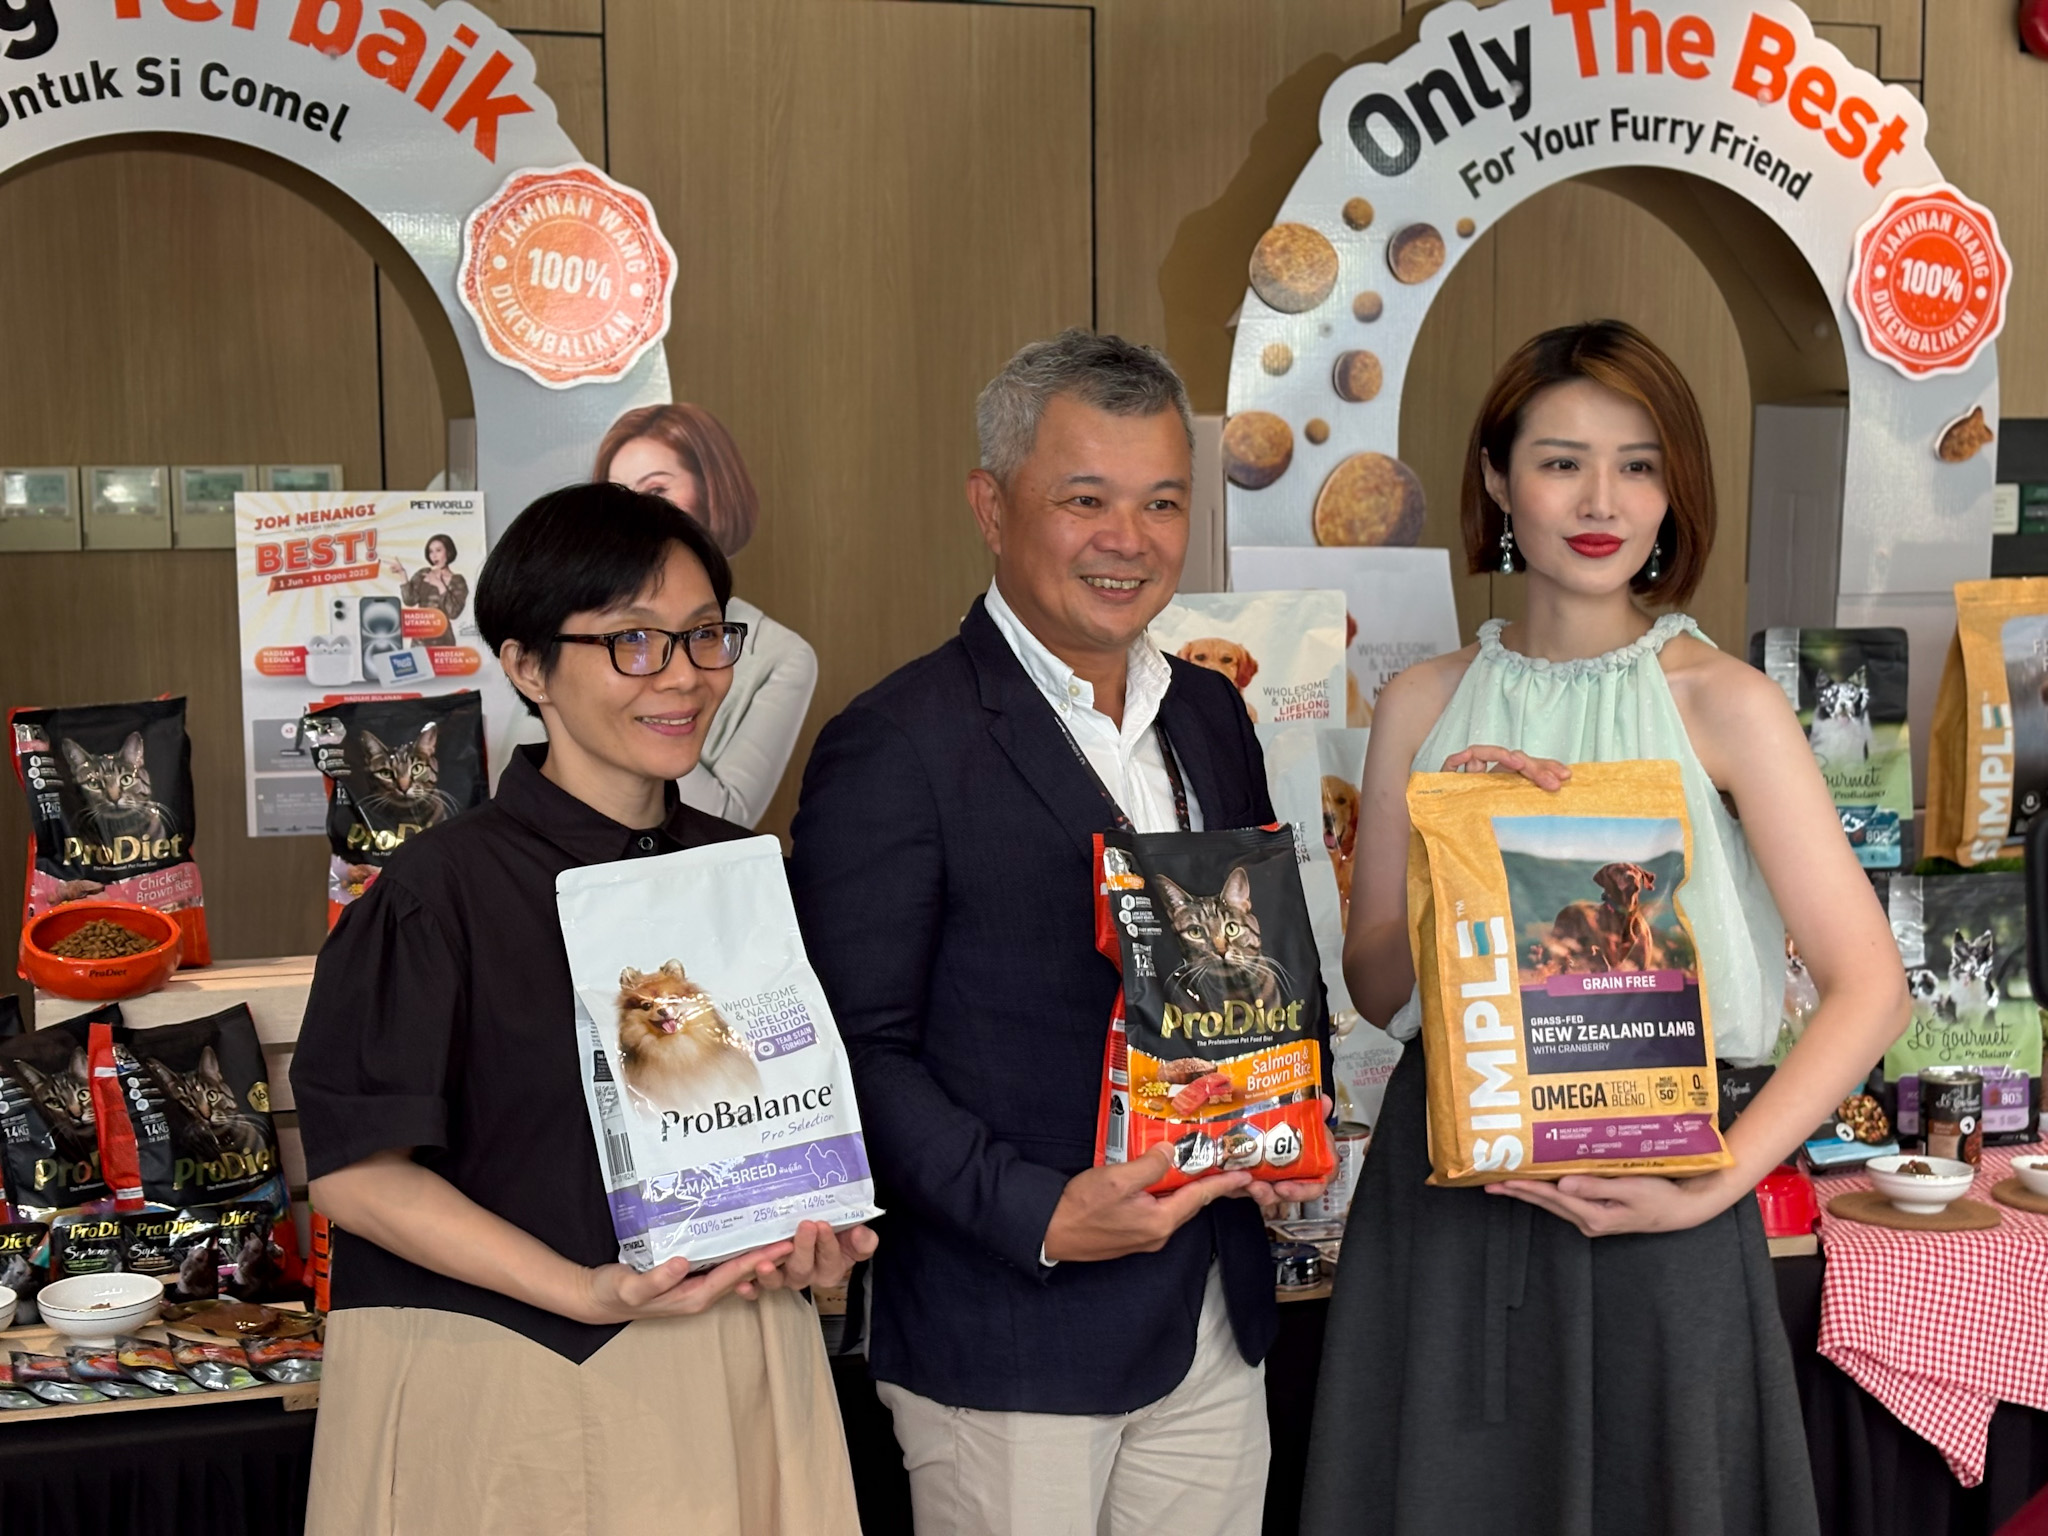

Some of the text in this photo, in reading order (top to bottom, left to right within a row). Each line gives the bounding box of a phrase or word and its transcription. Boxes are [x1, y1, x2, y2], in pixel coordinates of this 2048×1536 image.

[136, 57, 180, 97] Si
[200, 62, 350, 143] Comel
[1348, 0, 1909, 188] Only The Best
[1458, 107, 1813, 201] For Your Furry Friend
[499, 194, 646, 273] JAMINAN WANG
[1880, 210, 1989, 279] JAMINAN WANG
[528, 247, 612, 300] 100%
[1901, 258, 1963, 303] 100%
[490, 284, 635, 358] DIKEMBALIKAN
[1872, 289, 1978, 353] DIKEMBALIKAN
[255, 503, 376, 531] JOM MENANGI
[410, 500, 473, 510] PETWORLD
[255, 528, 377, 576] BEST!
[1263, 678, 1329, 697] WHOLESOME
[1282, 690, 1330, 706] NATURAL
[1280, 699, 1330, 715] LIFELONG
[1970, 703, 2014, 861] SIMPLE
[62, 833, 183, 866] ProDiet
[136, 879, 194, 903] Brown Rice
[139, 870, 184, 891] Chicken
[1582, 975, 1656, 990] GRAIN FREE
[721, 984, 798, 1012] WHOLESOME
[735, 995, 803, 1021] & NATURAL
[745, 1012, 811, 1040] NUTRITION
[747, 1003, 806, 1029] LIFELONG
[1160, 998, 1304, 1039] ProDiet
[1530, 1014, 1584, 1026] GRASS-FED
[775, 1026, 812, 1046] TEAR STAIN
[781, 1035, 813, 1052] FORMULA
[1208, 1038, 1239, 1046] Professional
[1456, 916, 1524, 1171] SIMPLE
[1531, 1021, 1696, 1043] NEW ZEALAND LAMB
[1533, 1042, 1610, 1054] WITH CRANBERRY
[1247, 1069, 1291, 1091] Brown
[1293, 1060, 1311, 1078] Rice
[1252, 1050, 1300, 1075] Salmon
[1354, 1064, 1397, 1078] LIFELON
[1531, 1082, 1608, 1111] OMEGA
[1611, 1081, 1637, 1093] TECH
[1611, 1092, 1646, 1107] BLEND
[662, 1086, 832, 1142] ProBalance
[761, 1114, 835, 1144] Pro Selection
[1274, 1136, 1292, 1155] GI
[731, 1162, 777, 1186] BREED
[753, 1206, 778, 1223] 25%
[69, 1221, 120, 1240] ProDi
[136, 1218, 202, 1238] ProDiet
